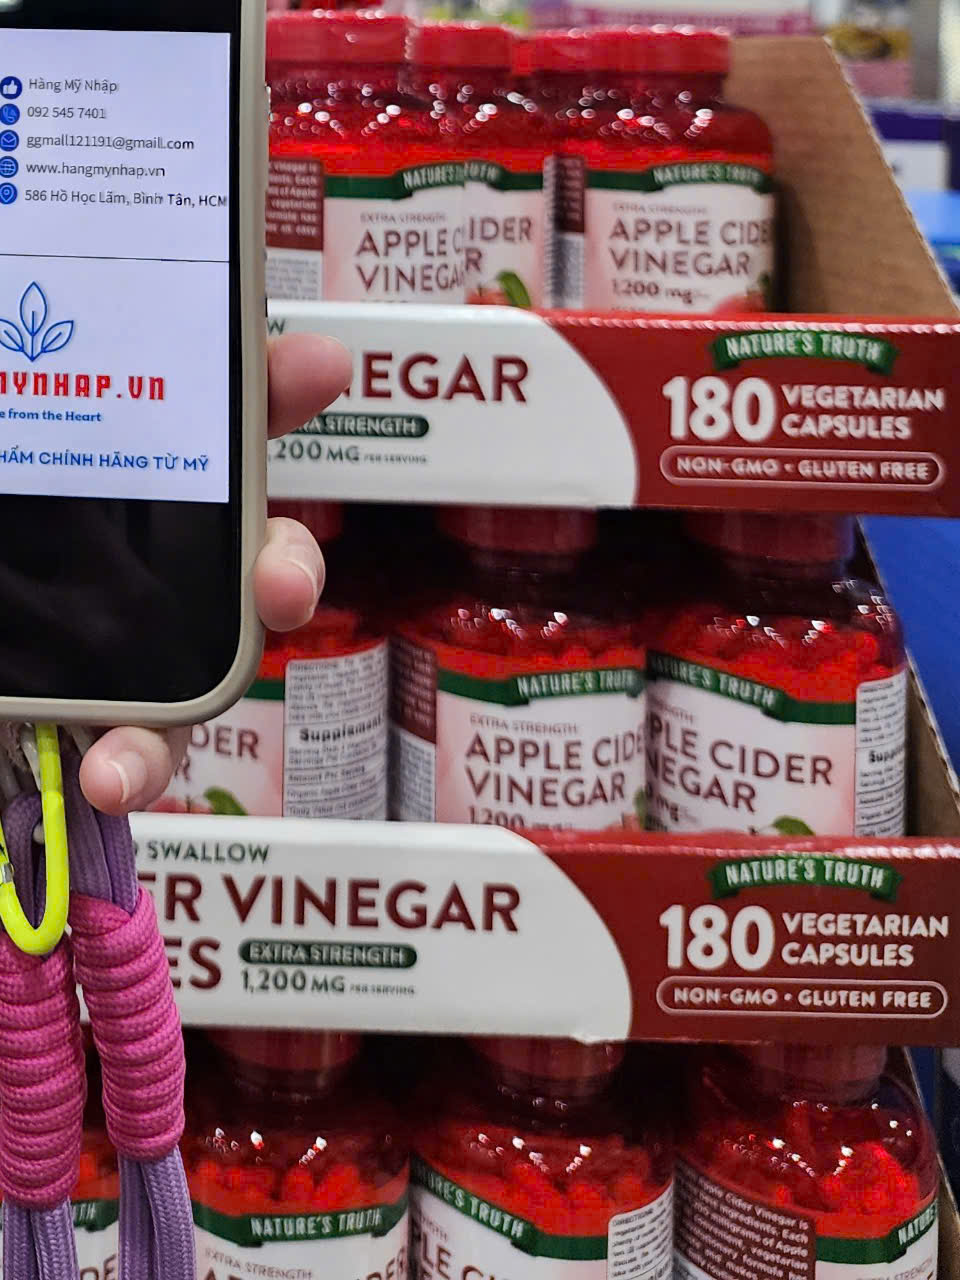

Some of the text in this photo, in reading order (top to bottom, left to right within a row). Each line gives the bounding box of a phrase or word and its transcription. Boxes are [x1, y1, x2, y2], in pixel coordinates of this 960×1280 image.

[29, 78, 61, 94] Hàng
[27, 106, 106, 120] 092 545 7401
[26, 162, 165, 178] www.hangmynhap.vn
[653, 163, 721, 185] NATURE'S
[25, 190, 47, 202] 586
[198, 195, 228, 207] HCM
[355, 228, 448, 257] APPLE
[469, 216, 533, 243] IDER
[609, 218, 709, 245] APPLE
[609, 247, 751, 277] VINEGAR
[726, 332, 882, 361] NATURE'S TRUTH
[662, 375, 776, 442] 180
[781, 384, 945, 410] VEGETARIAN
[7, 408, 39, 421] from
[42, 409, 62, 421] the
[65, 411, 101, 422] Heart
[326, 416, 416, 435] STRENGTH
[781, 413, 912, 440] CAPSULES
[39, 448, 94, 467] CHÍNH
[153, 455, 179, 470] TỪ
[183, 454, 208, 471] MỸ
[327, 445, 360, 462] MG
[676, 456, 929, 480] NON-GMO GLUTEN FREE
[517, 670, 593, 697] NATURE'S
[718, 673, 777, 711] TRUTH
[470, 713, 578, 734] EXTRA STRENGTH
[465, 731, 582, 772] APPLE
[648, 710, 699, 761] PLE
[709, 739, 834, 785] CIDER
[465, 765, 627, 807] VINEGAR
[646, 747, 756, 813] NEGAR
[147, 840, 270, 864] SWALLOW
[725, 859, 884, 888] NATURE'S TRUTH
[220, 874, 521, 933] VINEGAR
[659, 904, 776, 971] 180
[781, 912, 949, 939] VEGETARIAN
[249, 942, 405, 966] EXTRA STRENGTH
[781, 941, 915, 968] CAPSULES
[241, 969, 346, 994] 1,200 MG
[673, 987, 932, 1008] NON-GMO GLUTEN FREE
[251, 1209, 382, 1236] NATURE'S TRUTH
[469, 1195, 525, 1239] TRUTH
[755, 1205, 796, 1226] Vinegar
[782, 1229, 808, 1244] Each
[205, 1249, 312, 1279] EXTRA STRENGTH
